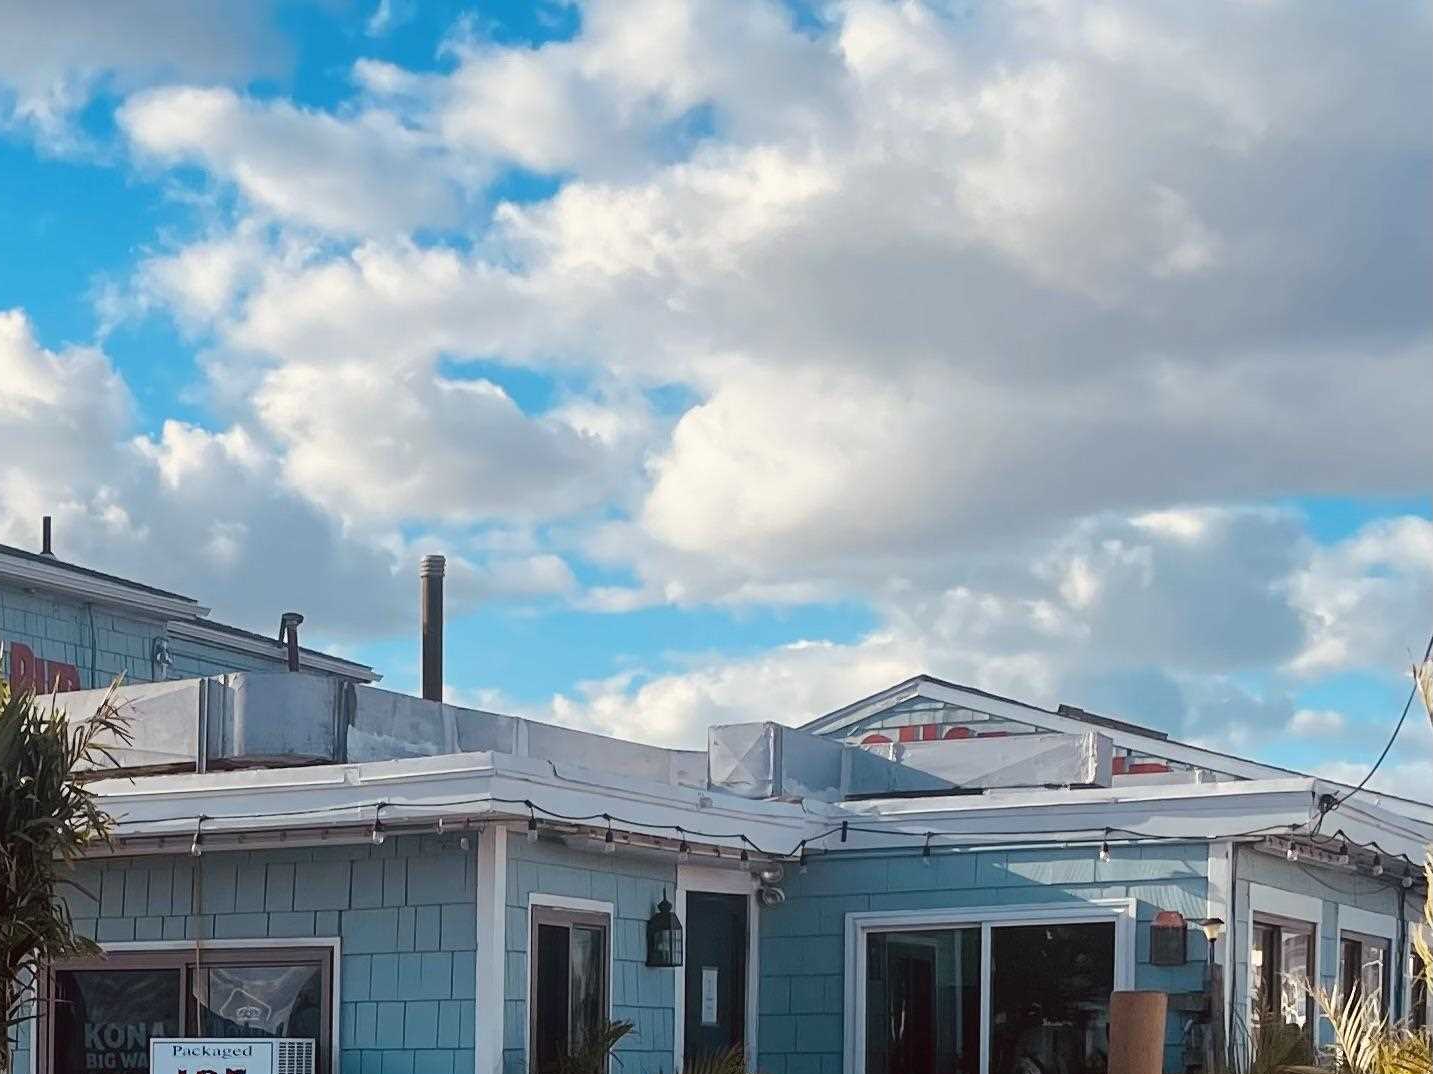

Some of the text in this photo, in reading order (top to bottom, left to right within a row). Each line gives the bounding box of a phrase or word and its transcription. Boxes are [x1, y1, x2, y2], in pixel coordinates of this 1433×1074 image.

[86, 1052, 149, 1069] BIG WA
[172, 1045, 254, 1060] Packaged
